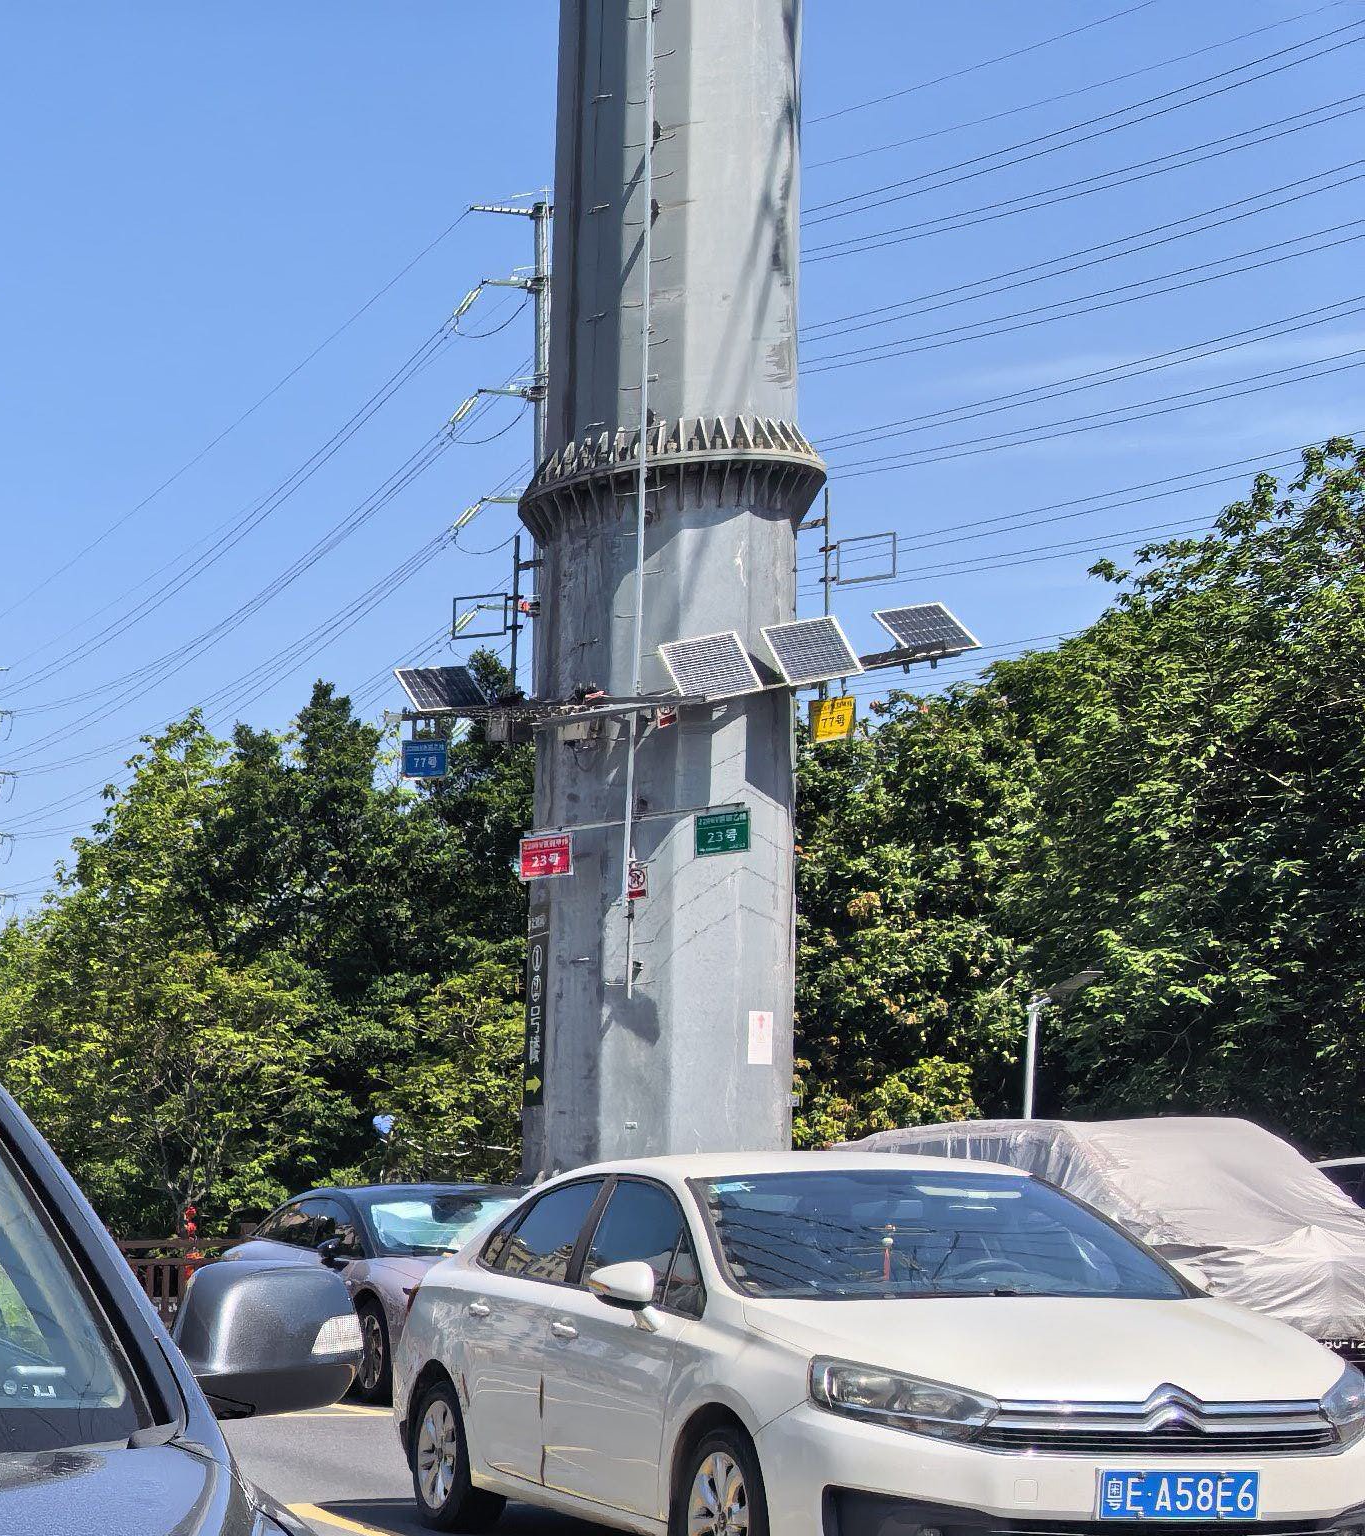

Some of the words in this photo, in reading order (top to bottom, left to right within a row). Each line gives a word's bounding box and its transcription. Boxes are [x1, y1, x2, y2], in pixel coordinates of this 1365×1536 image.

[820, 714, 845, 728] 77号
[413, 756, 437, 769] 77号
[707, 828, 738, 844] 23号
[531, 852, 561, 868] 23号
